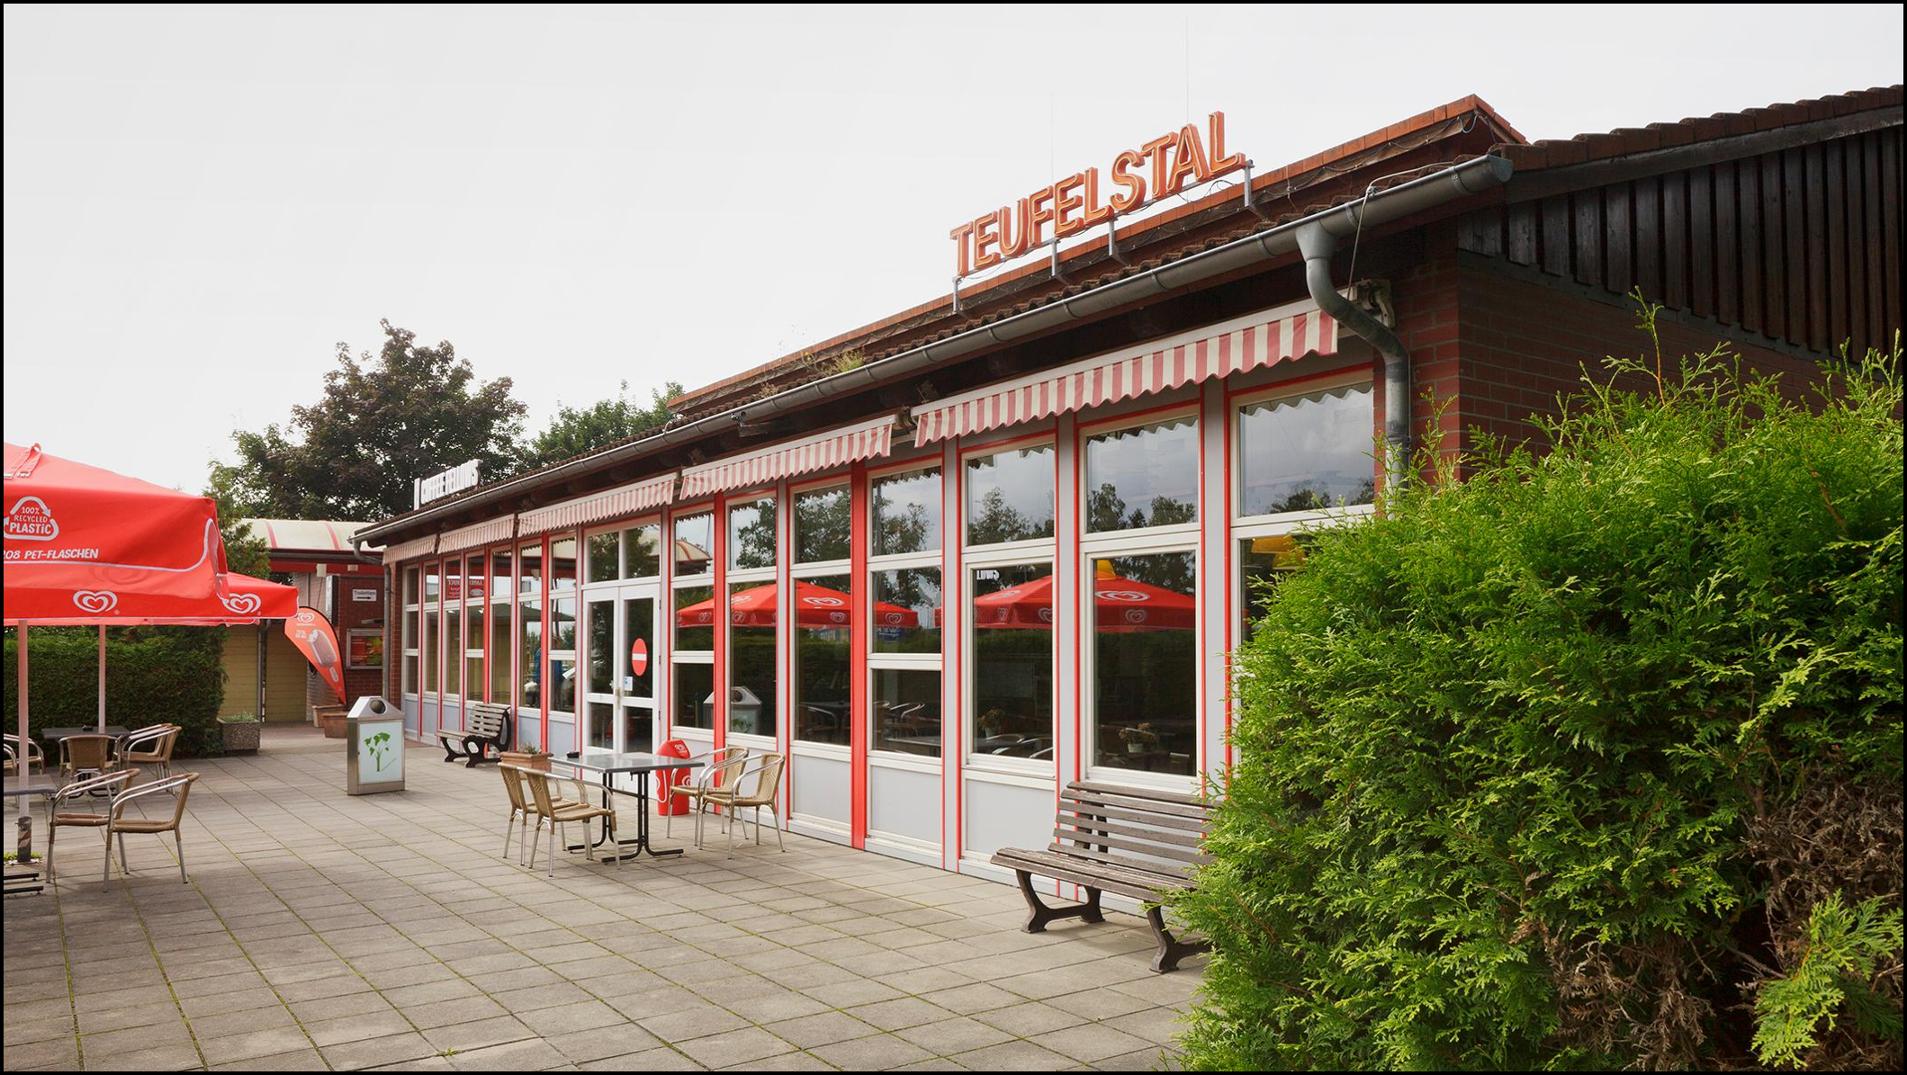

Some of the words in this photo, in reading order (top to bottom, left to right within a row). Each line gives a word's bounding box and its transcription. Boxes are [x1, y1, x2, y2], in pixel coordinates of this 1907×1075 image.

[950, 110, 1247, 278] TEUFELSTAL
[21, 506, 40, 514] 100%
[14, 514, 48, 523] RECYCLED
[24, 548, 99, 559] PET-FLASCHEN
